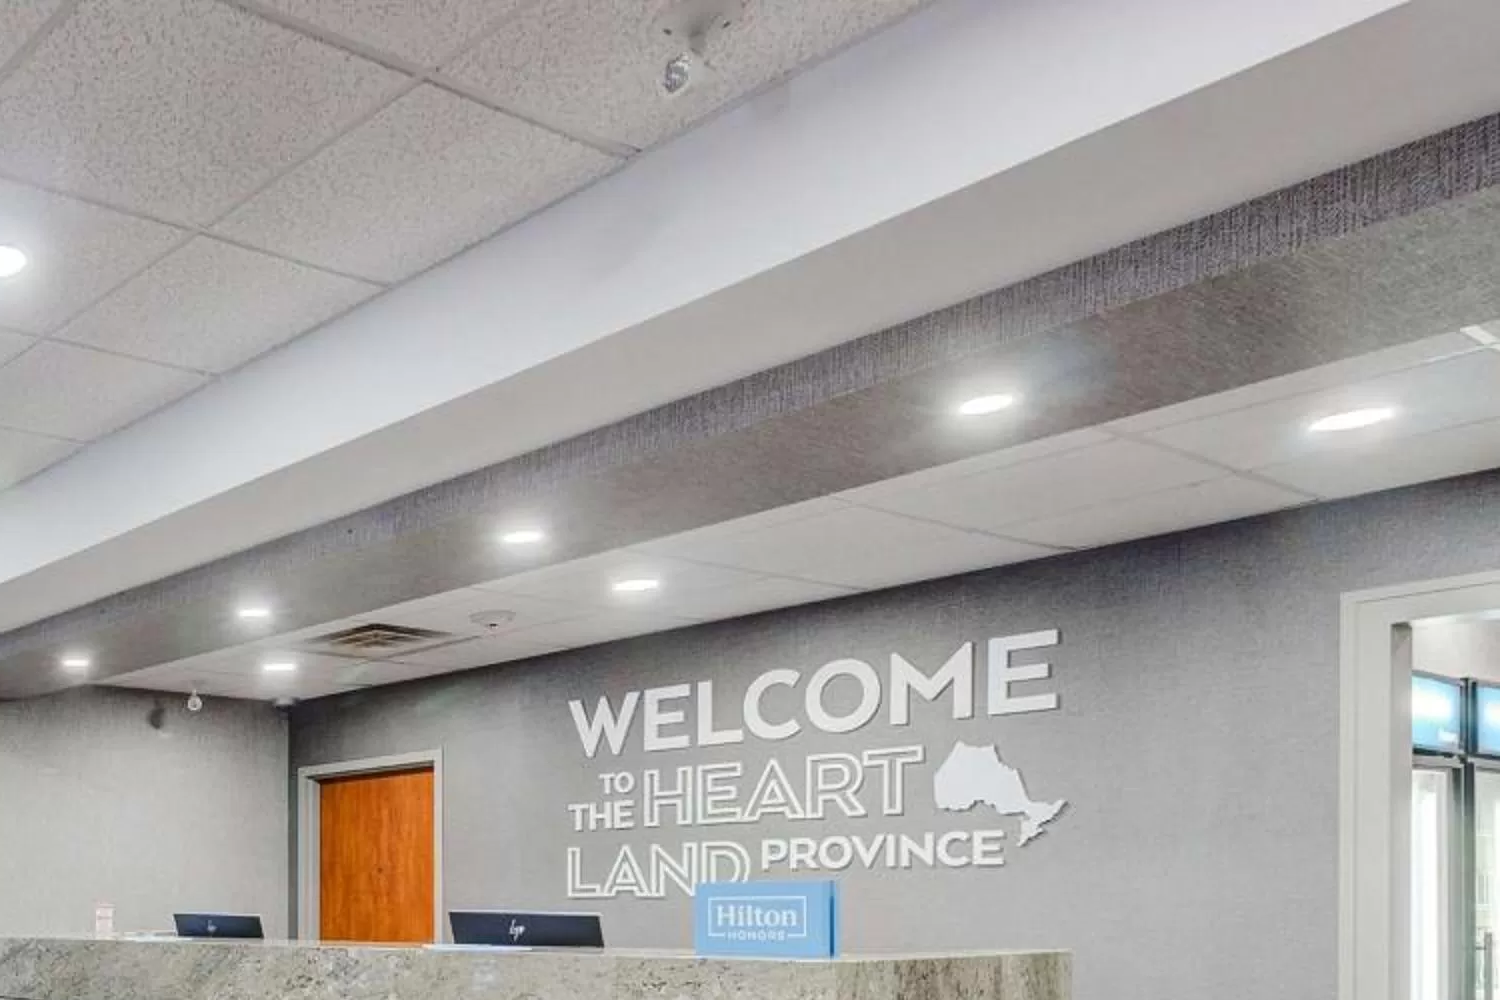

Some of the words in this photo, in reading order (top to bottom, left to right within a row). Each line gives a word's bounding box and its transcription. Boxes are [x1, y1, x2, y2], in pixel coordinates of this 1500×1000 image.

[568, 629, 1061, 758] WELCOME
[600, 770, 636, 796] TO
[643, 745, 925, 828] HEART
[568, 800, 635, 831] THE
[567, 841, 751, 899] LAND
[761, 830, 1005, 871] PROVINCE
[716, 905, 797, 927] Hilton
[728, 930, 786, 941] HONORS
